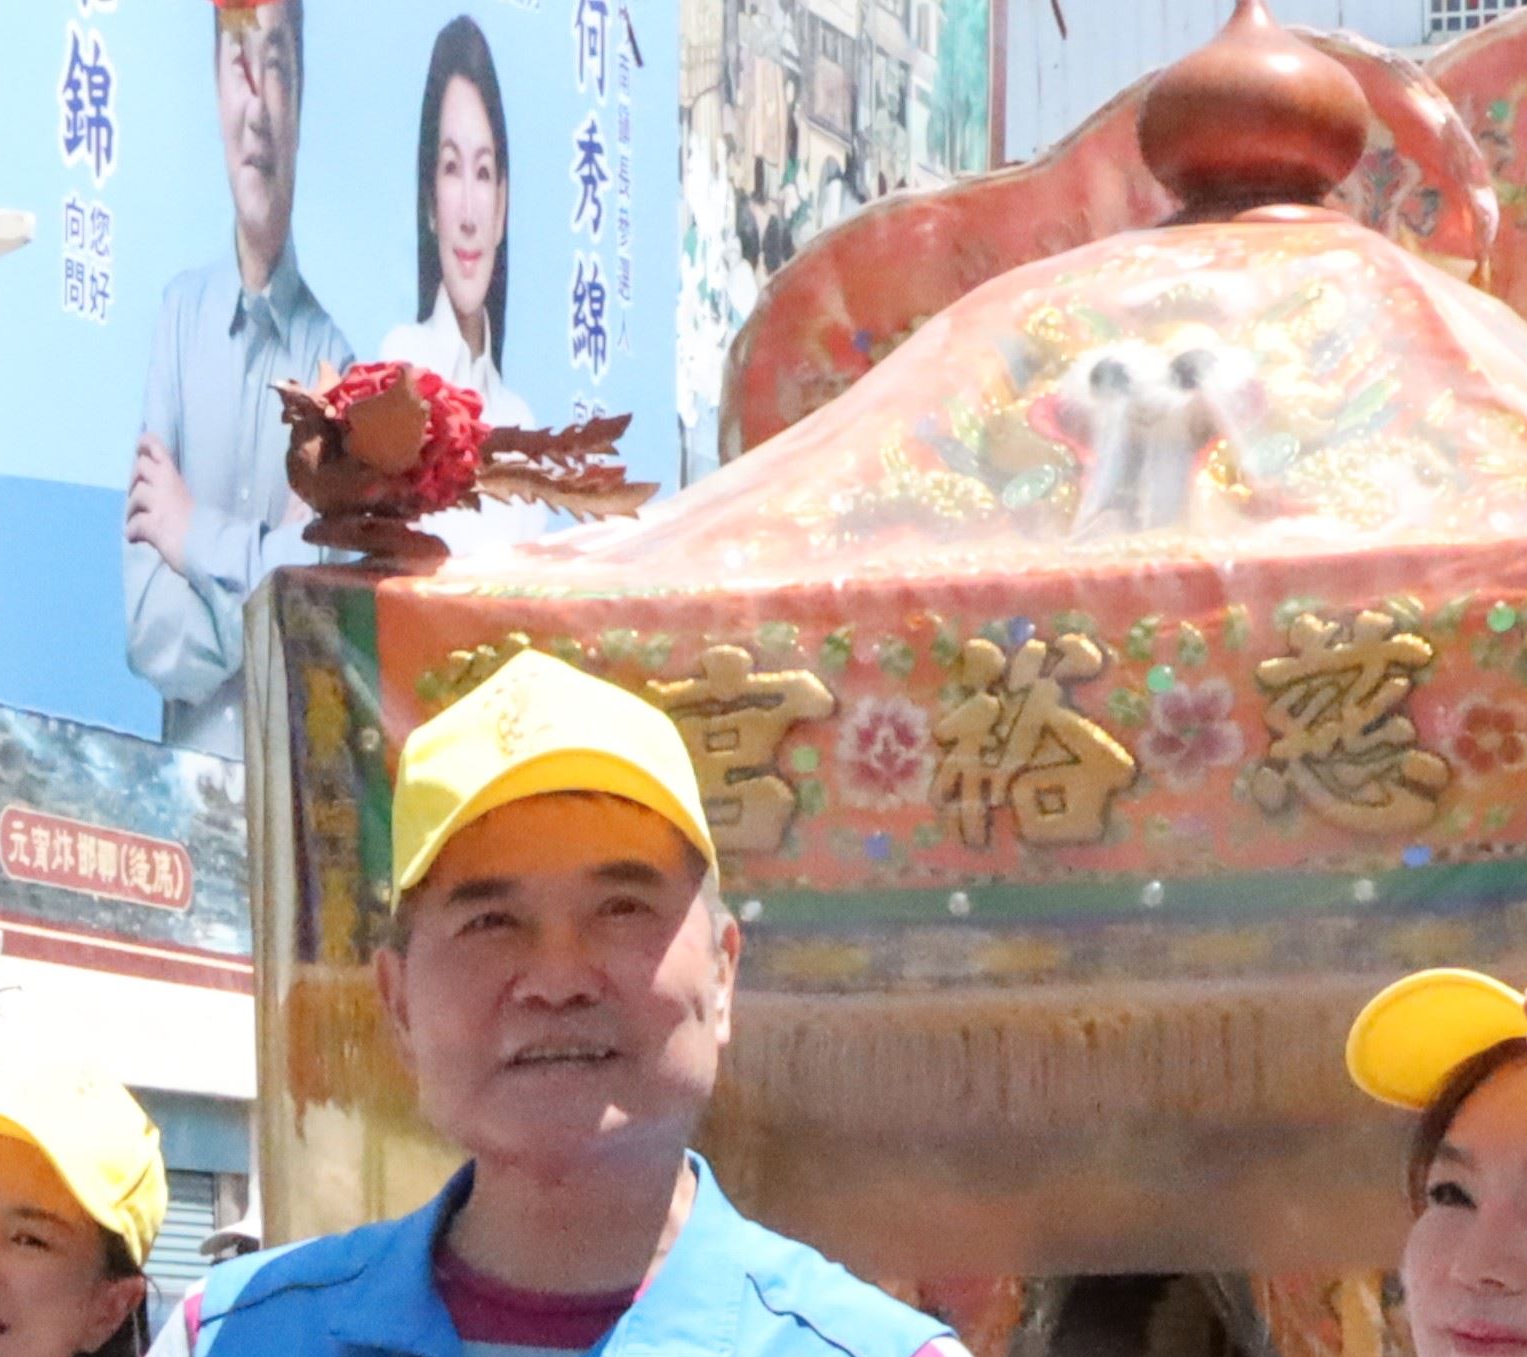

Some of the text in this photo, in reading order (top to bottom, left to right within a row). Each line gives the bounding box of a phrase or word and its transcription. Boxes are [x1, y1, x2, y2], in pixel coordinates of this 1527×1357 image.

[61, 0, 114, 179] 錦
[573, 0, 609, 375] 何秀綿
